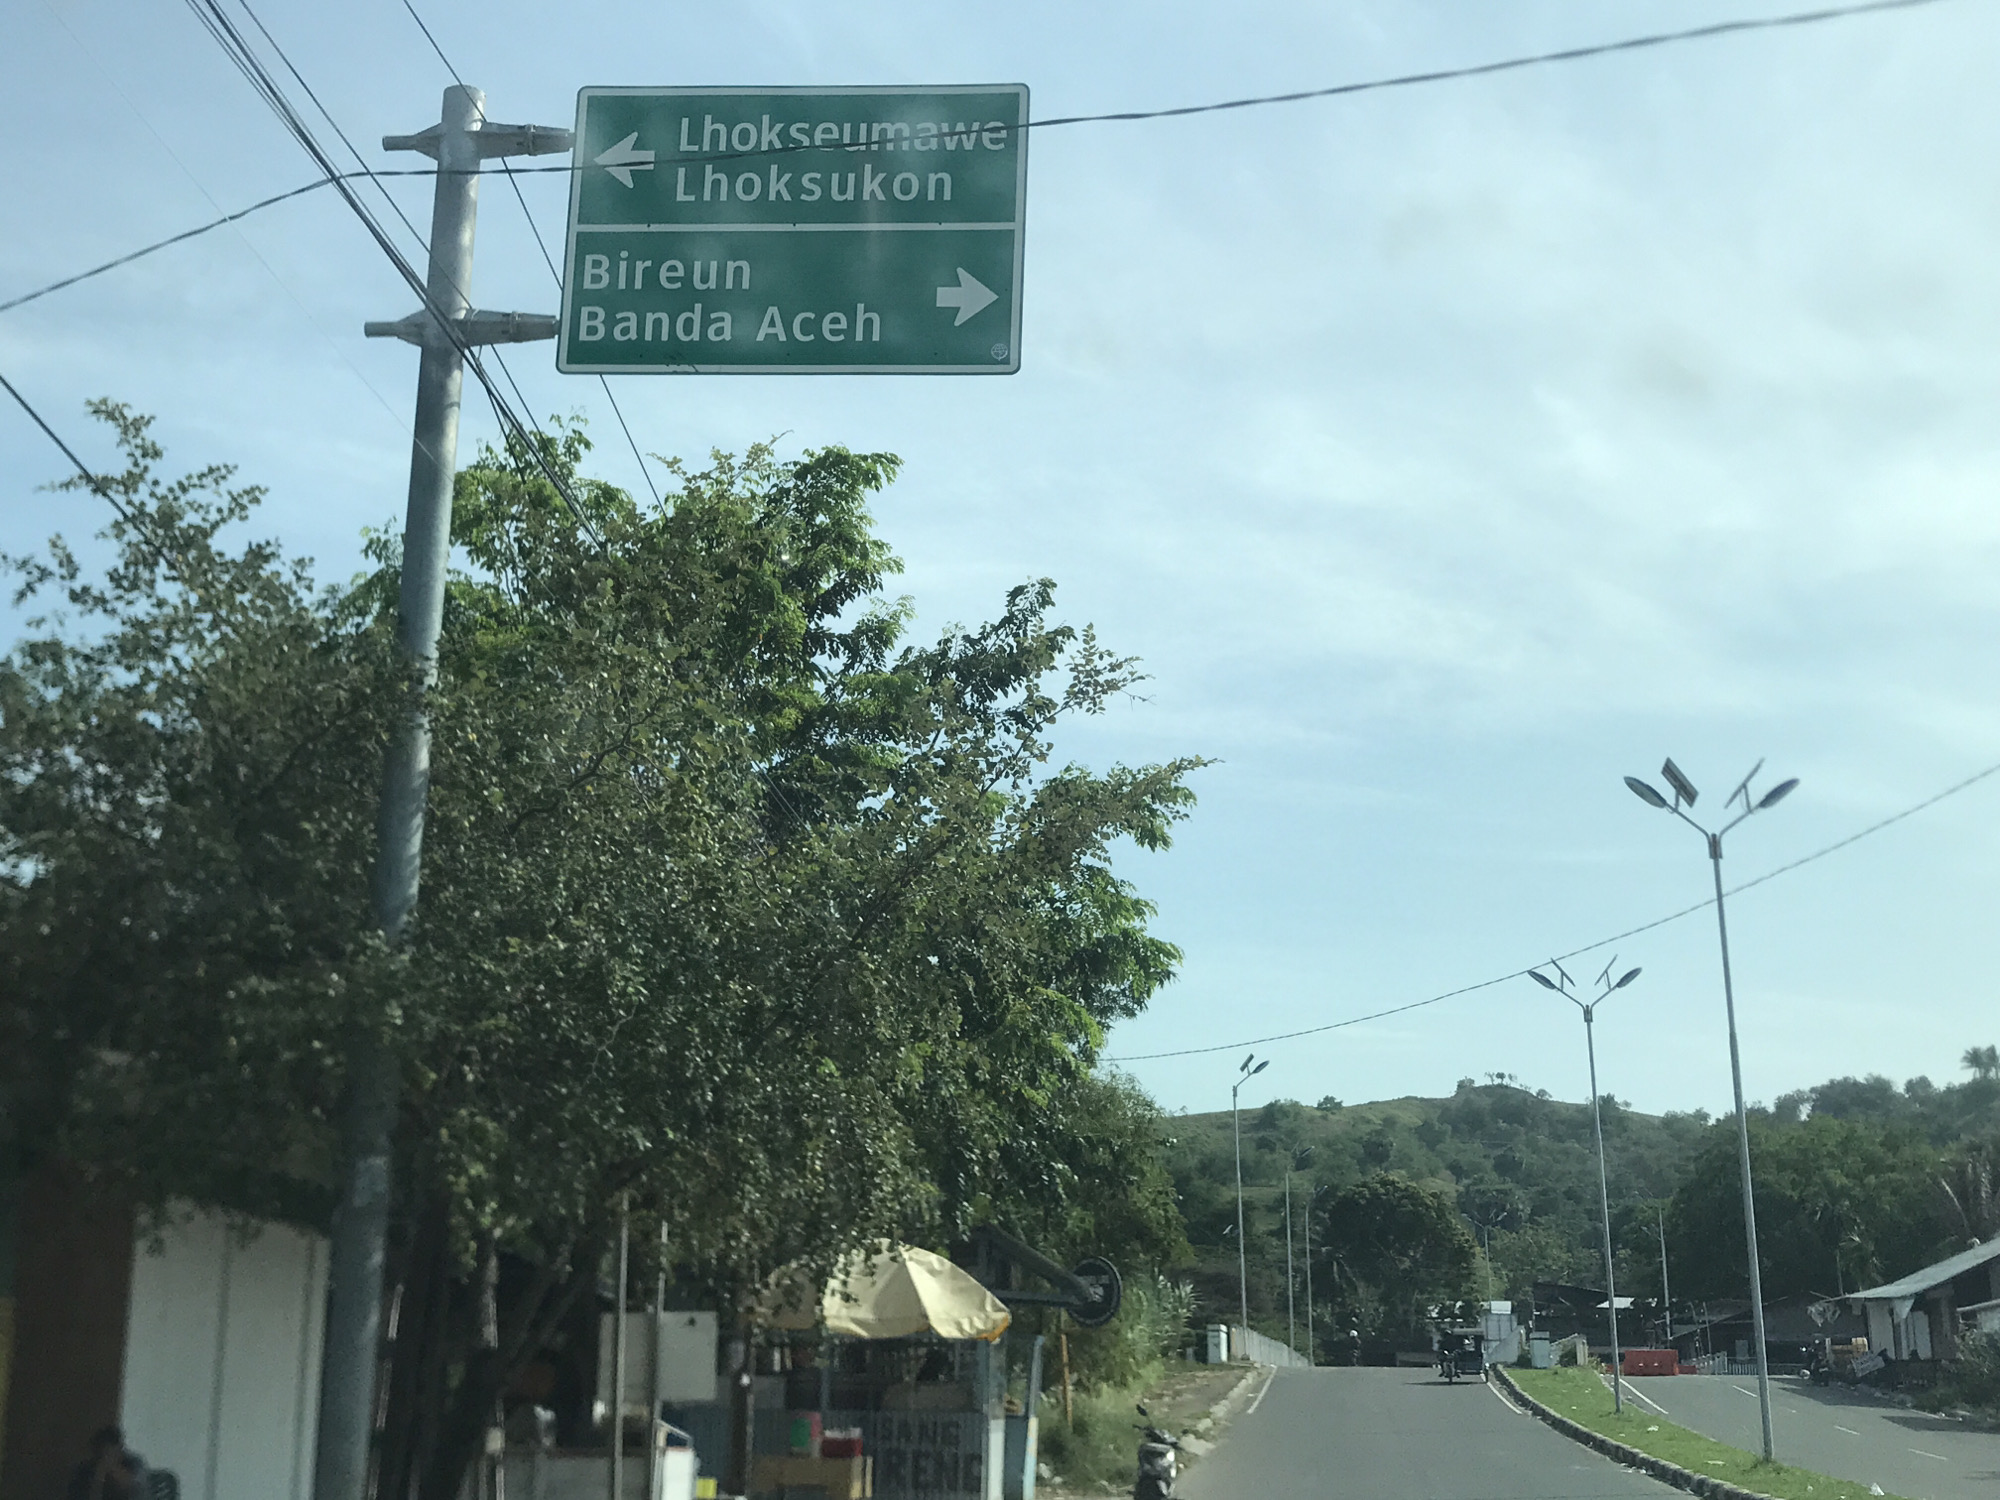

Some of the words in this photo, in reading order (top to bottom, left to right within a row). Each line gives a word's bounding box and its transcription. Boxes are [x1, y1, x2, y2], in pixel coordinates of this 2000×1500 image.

[678, 114, 1008, 153] Lhokseumawe
[675, 164, 953, 201] Lhoksukon
[582, 250, 751, 291] Bireun
[578, 303, 733, 342] Banda
[755, 303, 882, 342] Aceh
